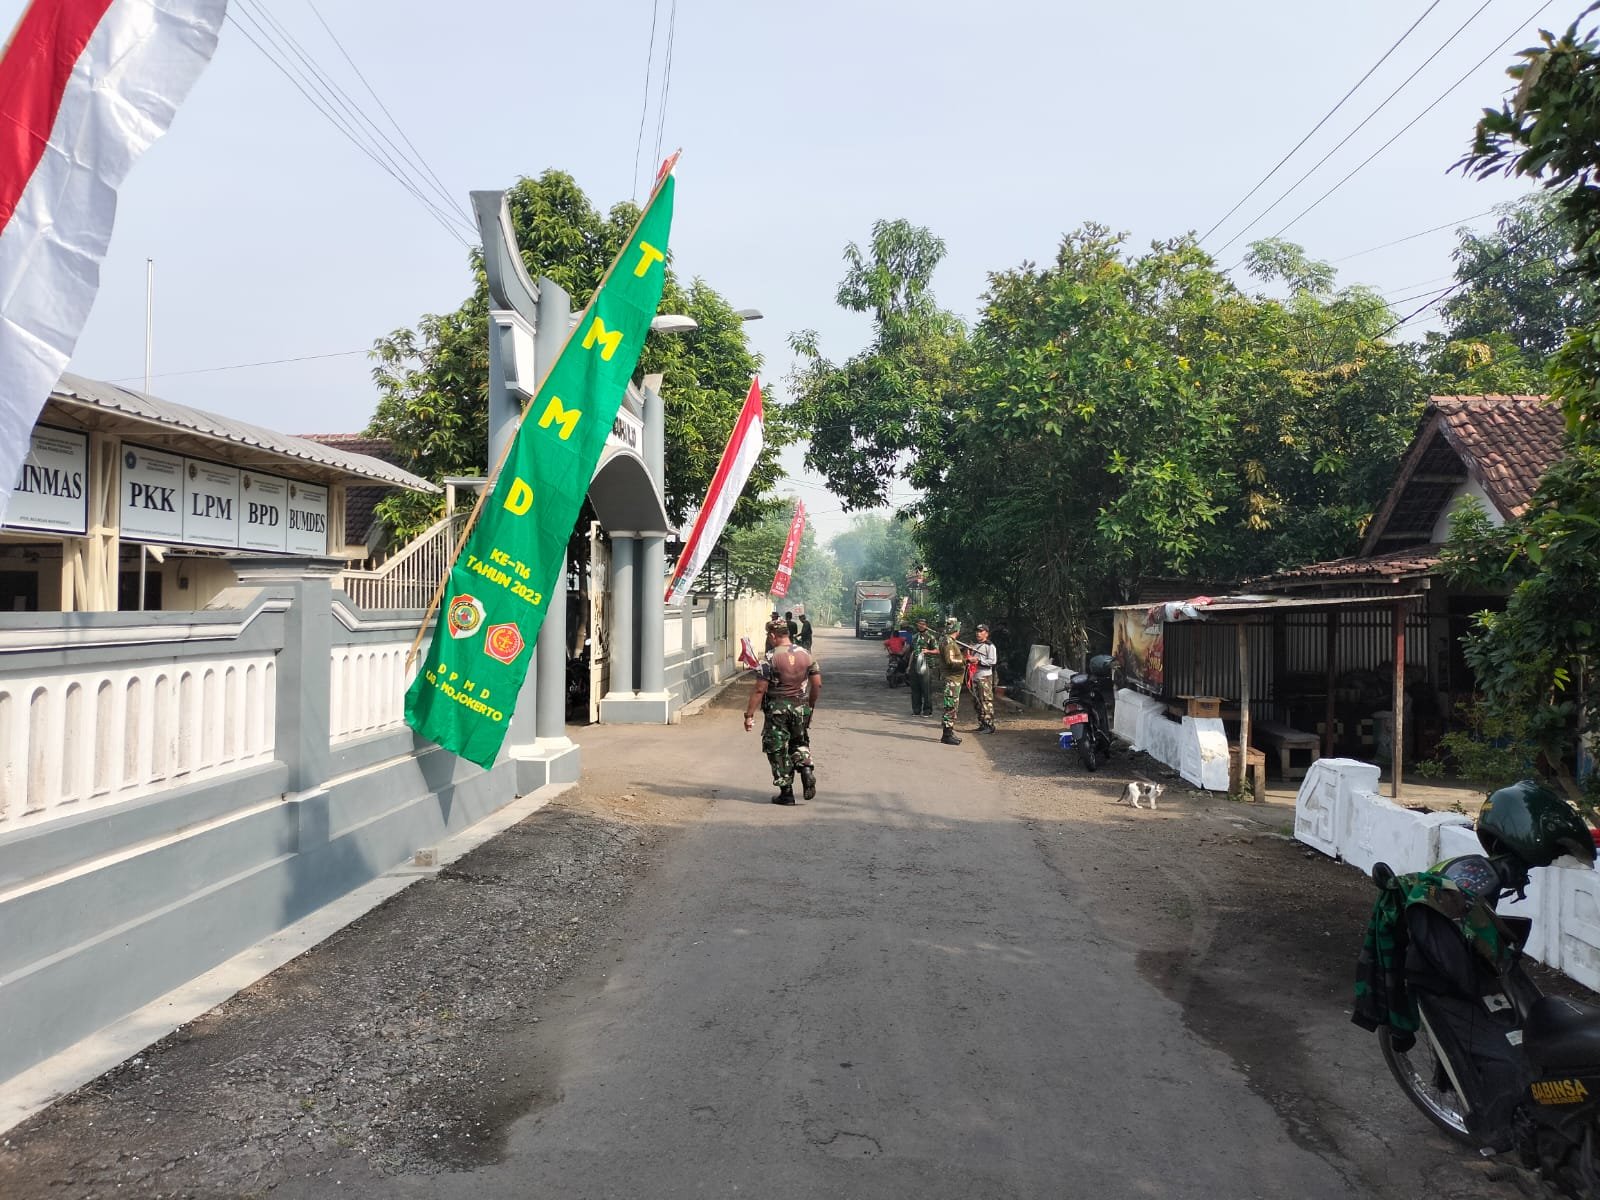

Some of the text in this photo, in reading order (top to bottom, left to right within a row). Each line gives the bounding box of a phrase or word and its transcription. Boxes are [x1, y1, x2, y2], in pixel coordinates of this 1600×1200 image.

[129, 481, 176, 513] PKK
[192, 492, 233, 521] LPM
[248, 502, 279, 527] BPD
[289, 509, 326, 534] BUMDES
[489, 548, 531, 579] KE-116
[466, 555, 542, 605] TAHUN 2023
[440, 681, 503, 721] MOJOKERTO
[1531, 1079, 1589, 1100] BABINSA
